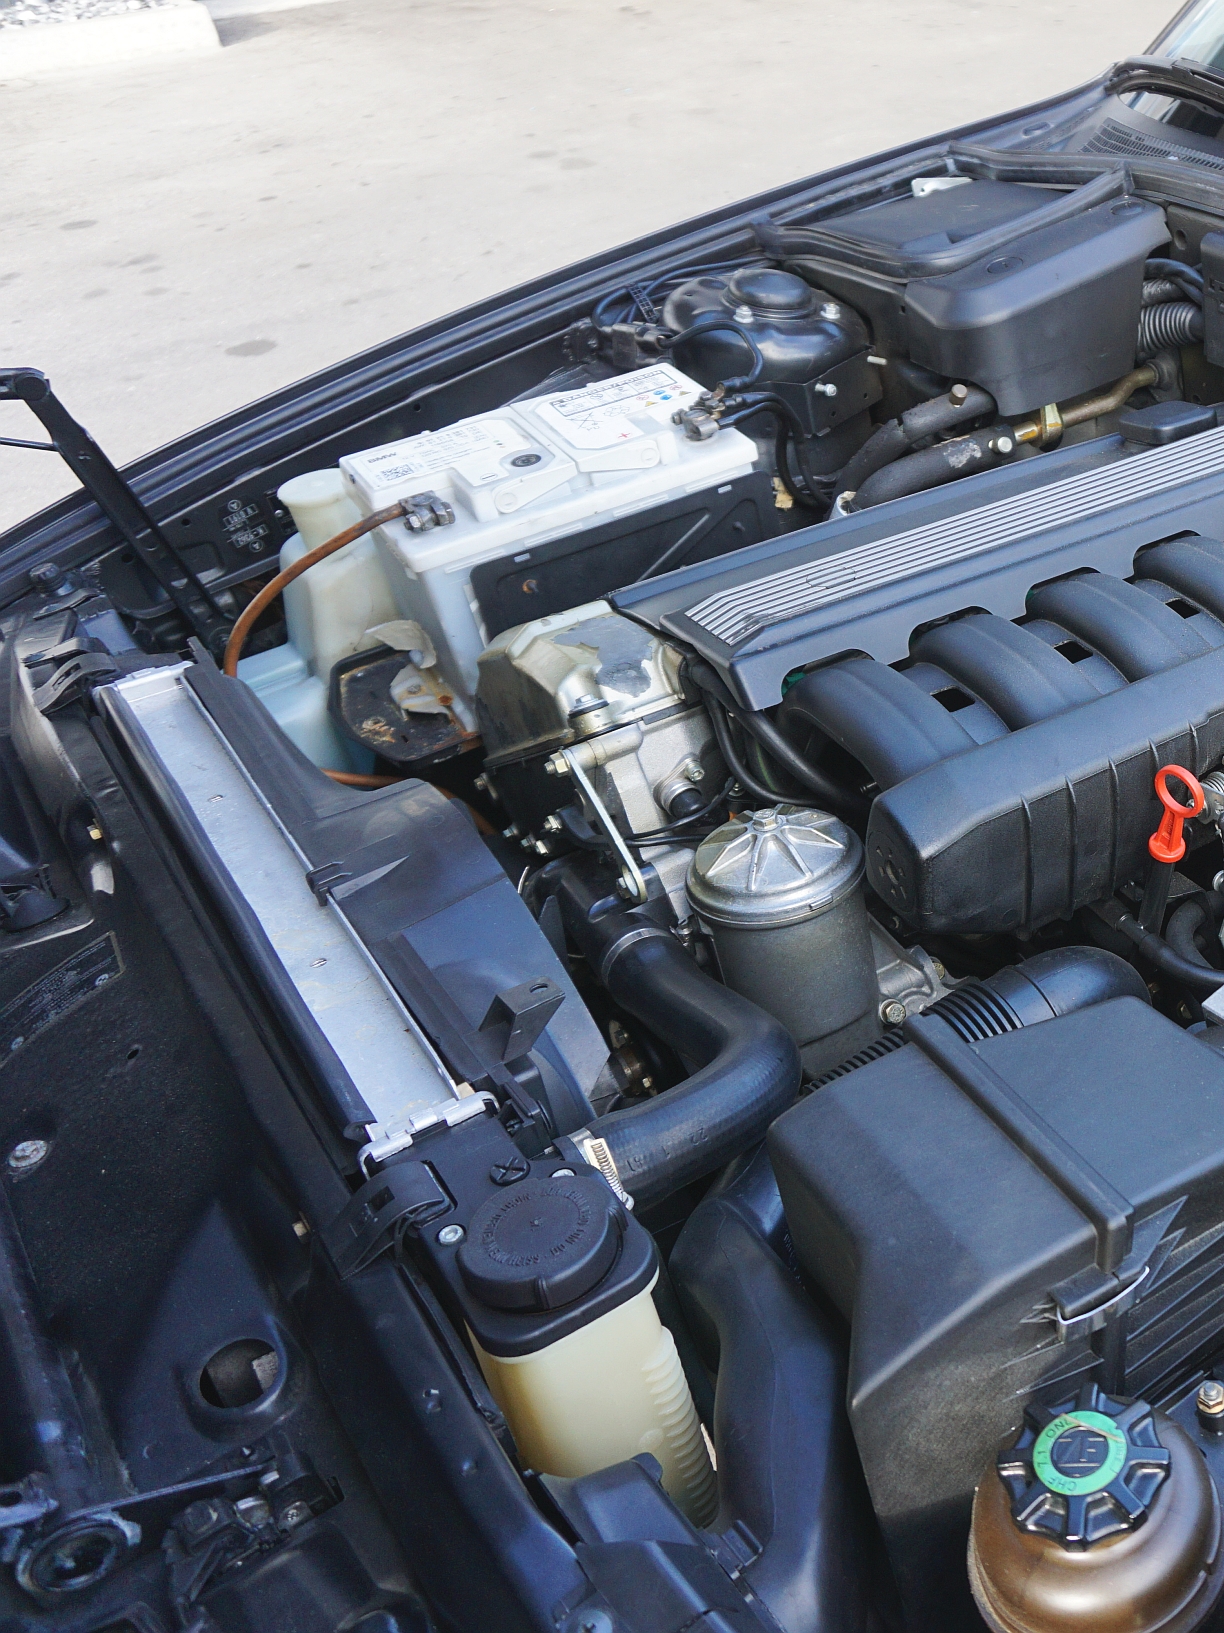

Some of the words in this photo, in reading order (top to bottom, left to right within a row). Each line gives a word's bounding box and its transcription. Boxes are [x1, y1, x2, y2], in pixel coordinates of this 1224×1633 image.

[368, 452, 396, 464] BMW
[1037, 1450, 1049, 1469] 7.1
[1047, 1476, 1077, 1492] CHF
